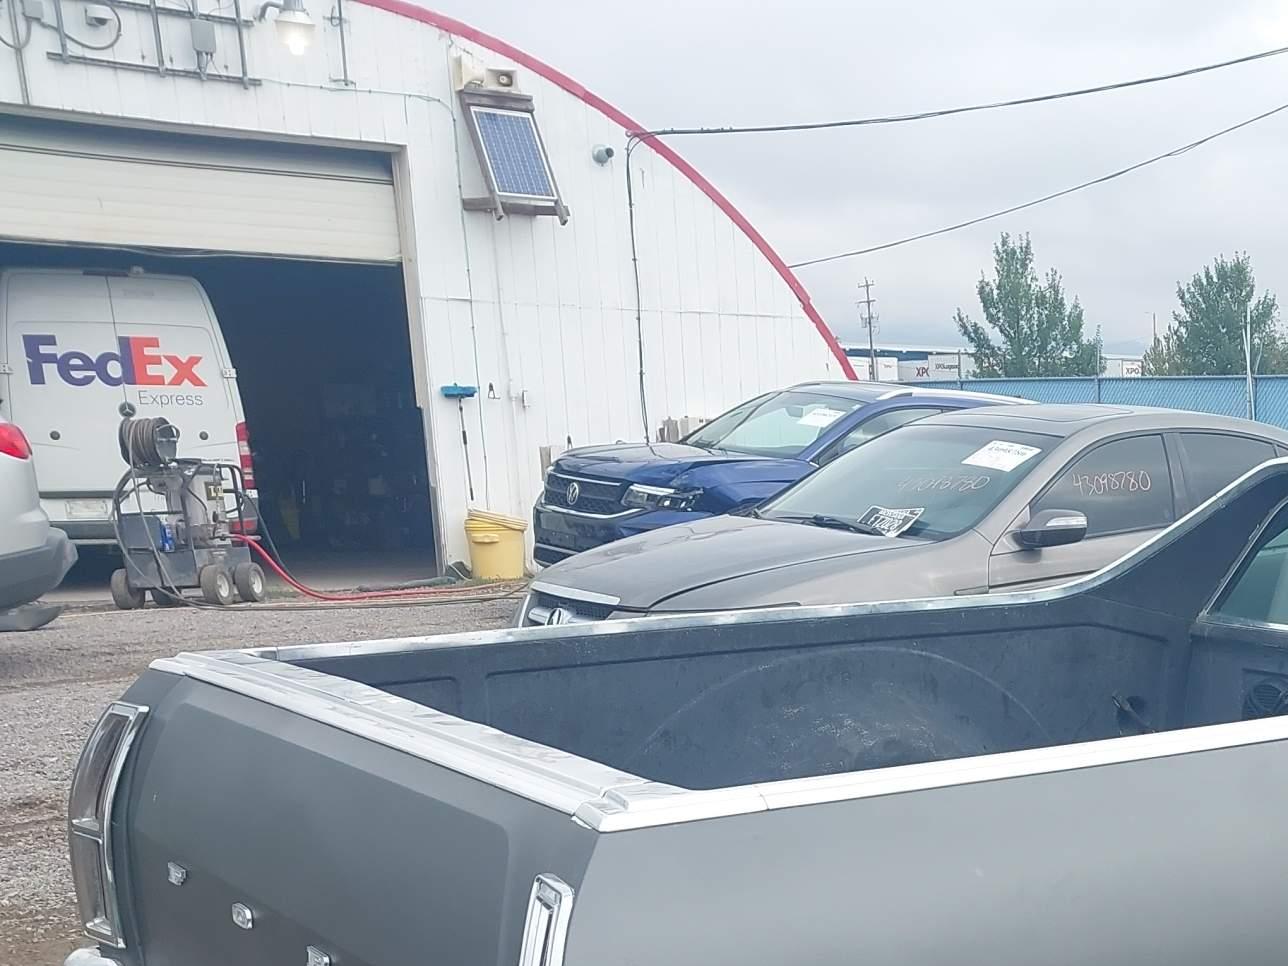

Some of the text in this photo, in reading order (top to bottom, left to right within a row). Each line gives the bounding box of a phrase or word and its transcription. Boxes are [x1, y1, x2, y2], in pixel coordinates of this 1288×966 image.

[22, 334, 208, 387] FedEx
[138, 390, 203, 408] Express
[1072, 470, 1151, 496] 43098780
